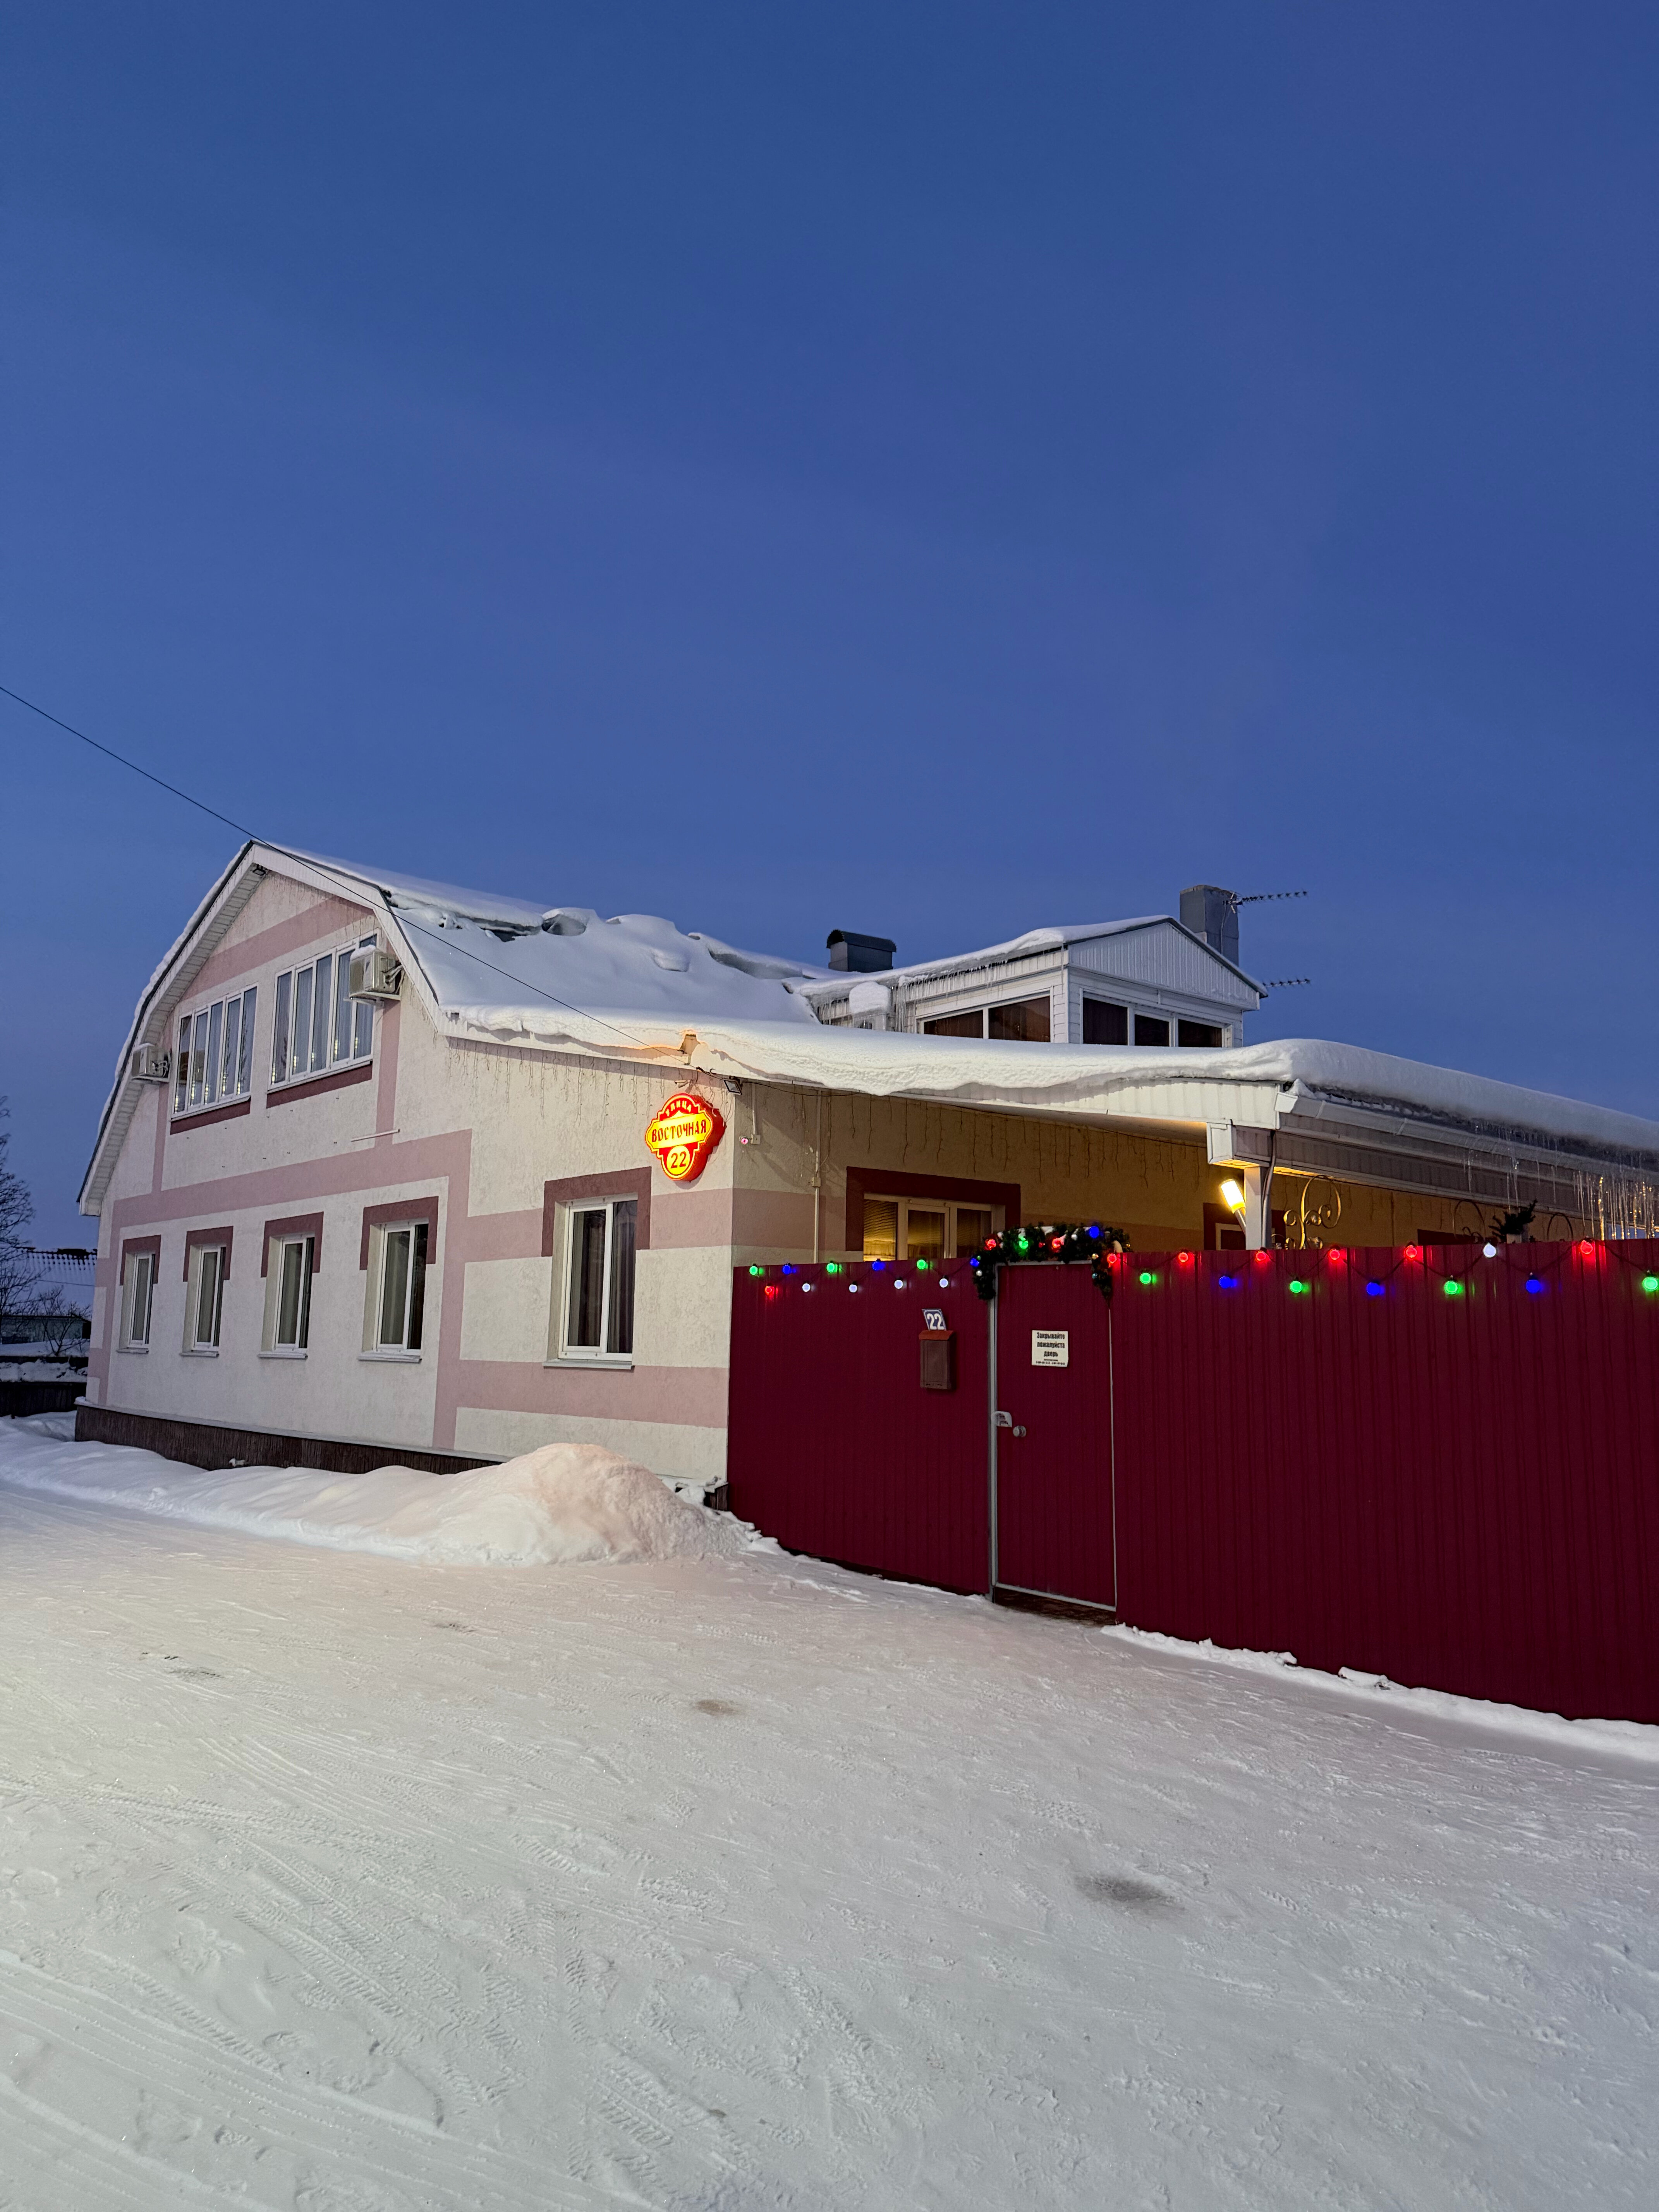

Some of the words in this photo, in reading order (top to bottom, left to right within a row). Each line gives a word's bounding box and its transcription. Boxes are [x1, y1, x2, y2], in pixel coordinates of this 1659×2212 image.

[665, 1100, 692, 1117] УЛИЦА
[651, 1119, 707, 1142] ВОСТОЧНАЯ
[670, 1151, 687, 1169] 22
[927, 1313, 945, 1330] 22
